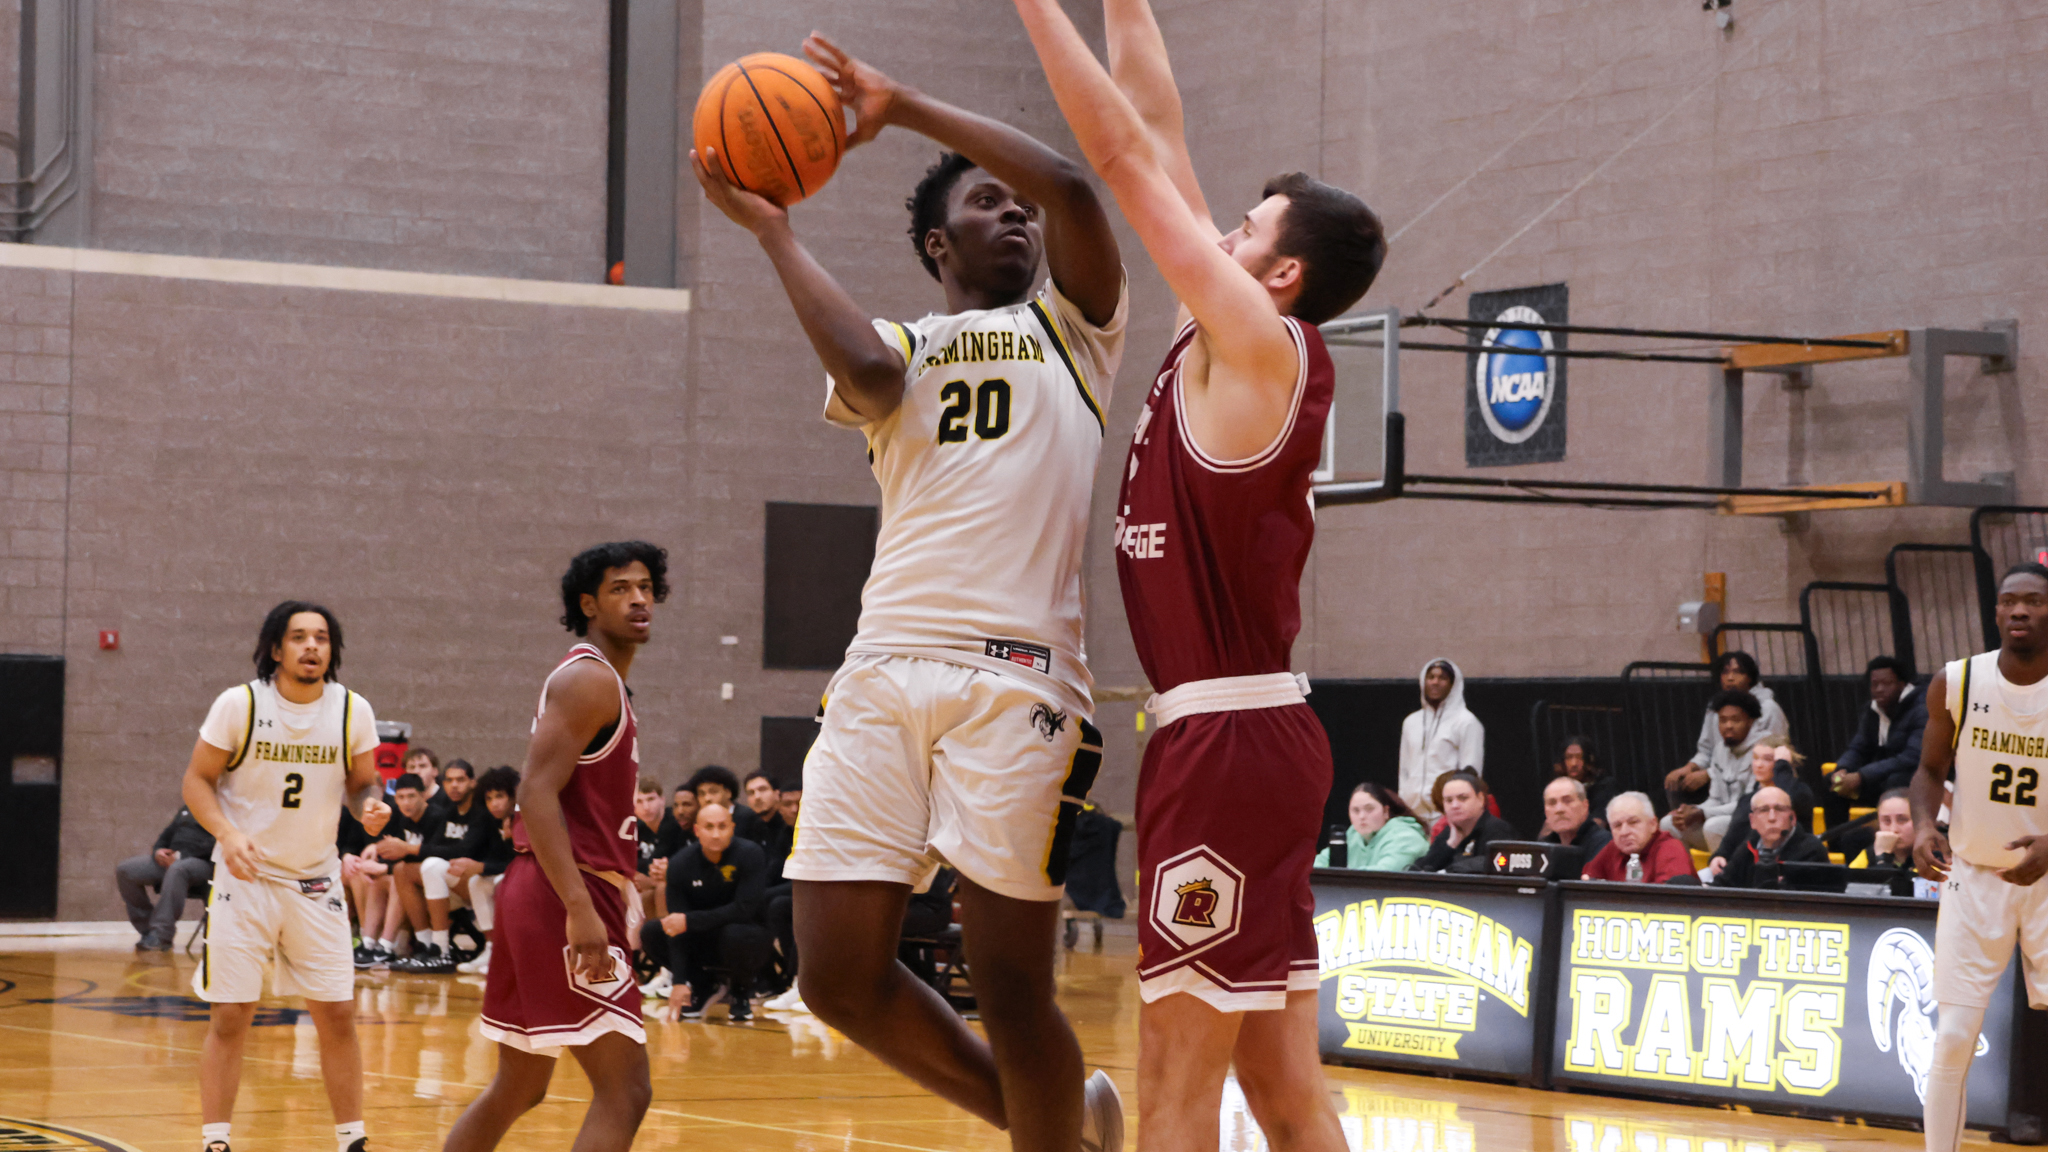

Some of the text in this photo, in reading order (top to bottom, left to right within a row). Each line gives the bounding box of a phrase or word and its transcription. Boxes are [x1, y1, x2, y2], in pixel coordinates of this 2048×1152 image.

[939, 377, 1012, 446] 20
[1490, 372, 1546, 404] NCAA
[255, 741, 338, 765] FRAMINGHAM
[282, 772, 304, 809] 2
[1989, 763, 2039, 807] 22
[1313, 901, 1531, 1010] RAMINGHAM
[1576, 915, 1844, 977] HOME OF THE
[1339, 974, 1476, 1025] STATE
[1356, 1028, 1448, 1053] UNIVERSITY
[1570, 973, 1840, 1091] RAMS
